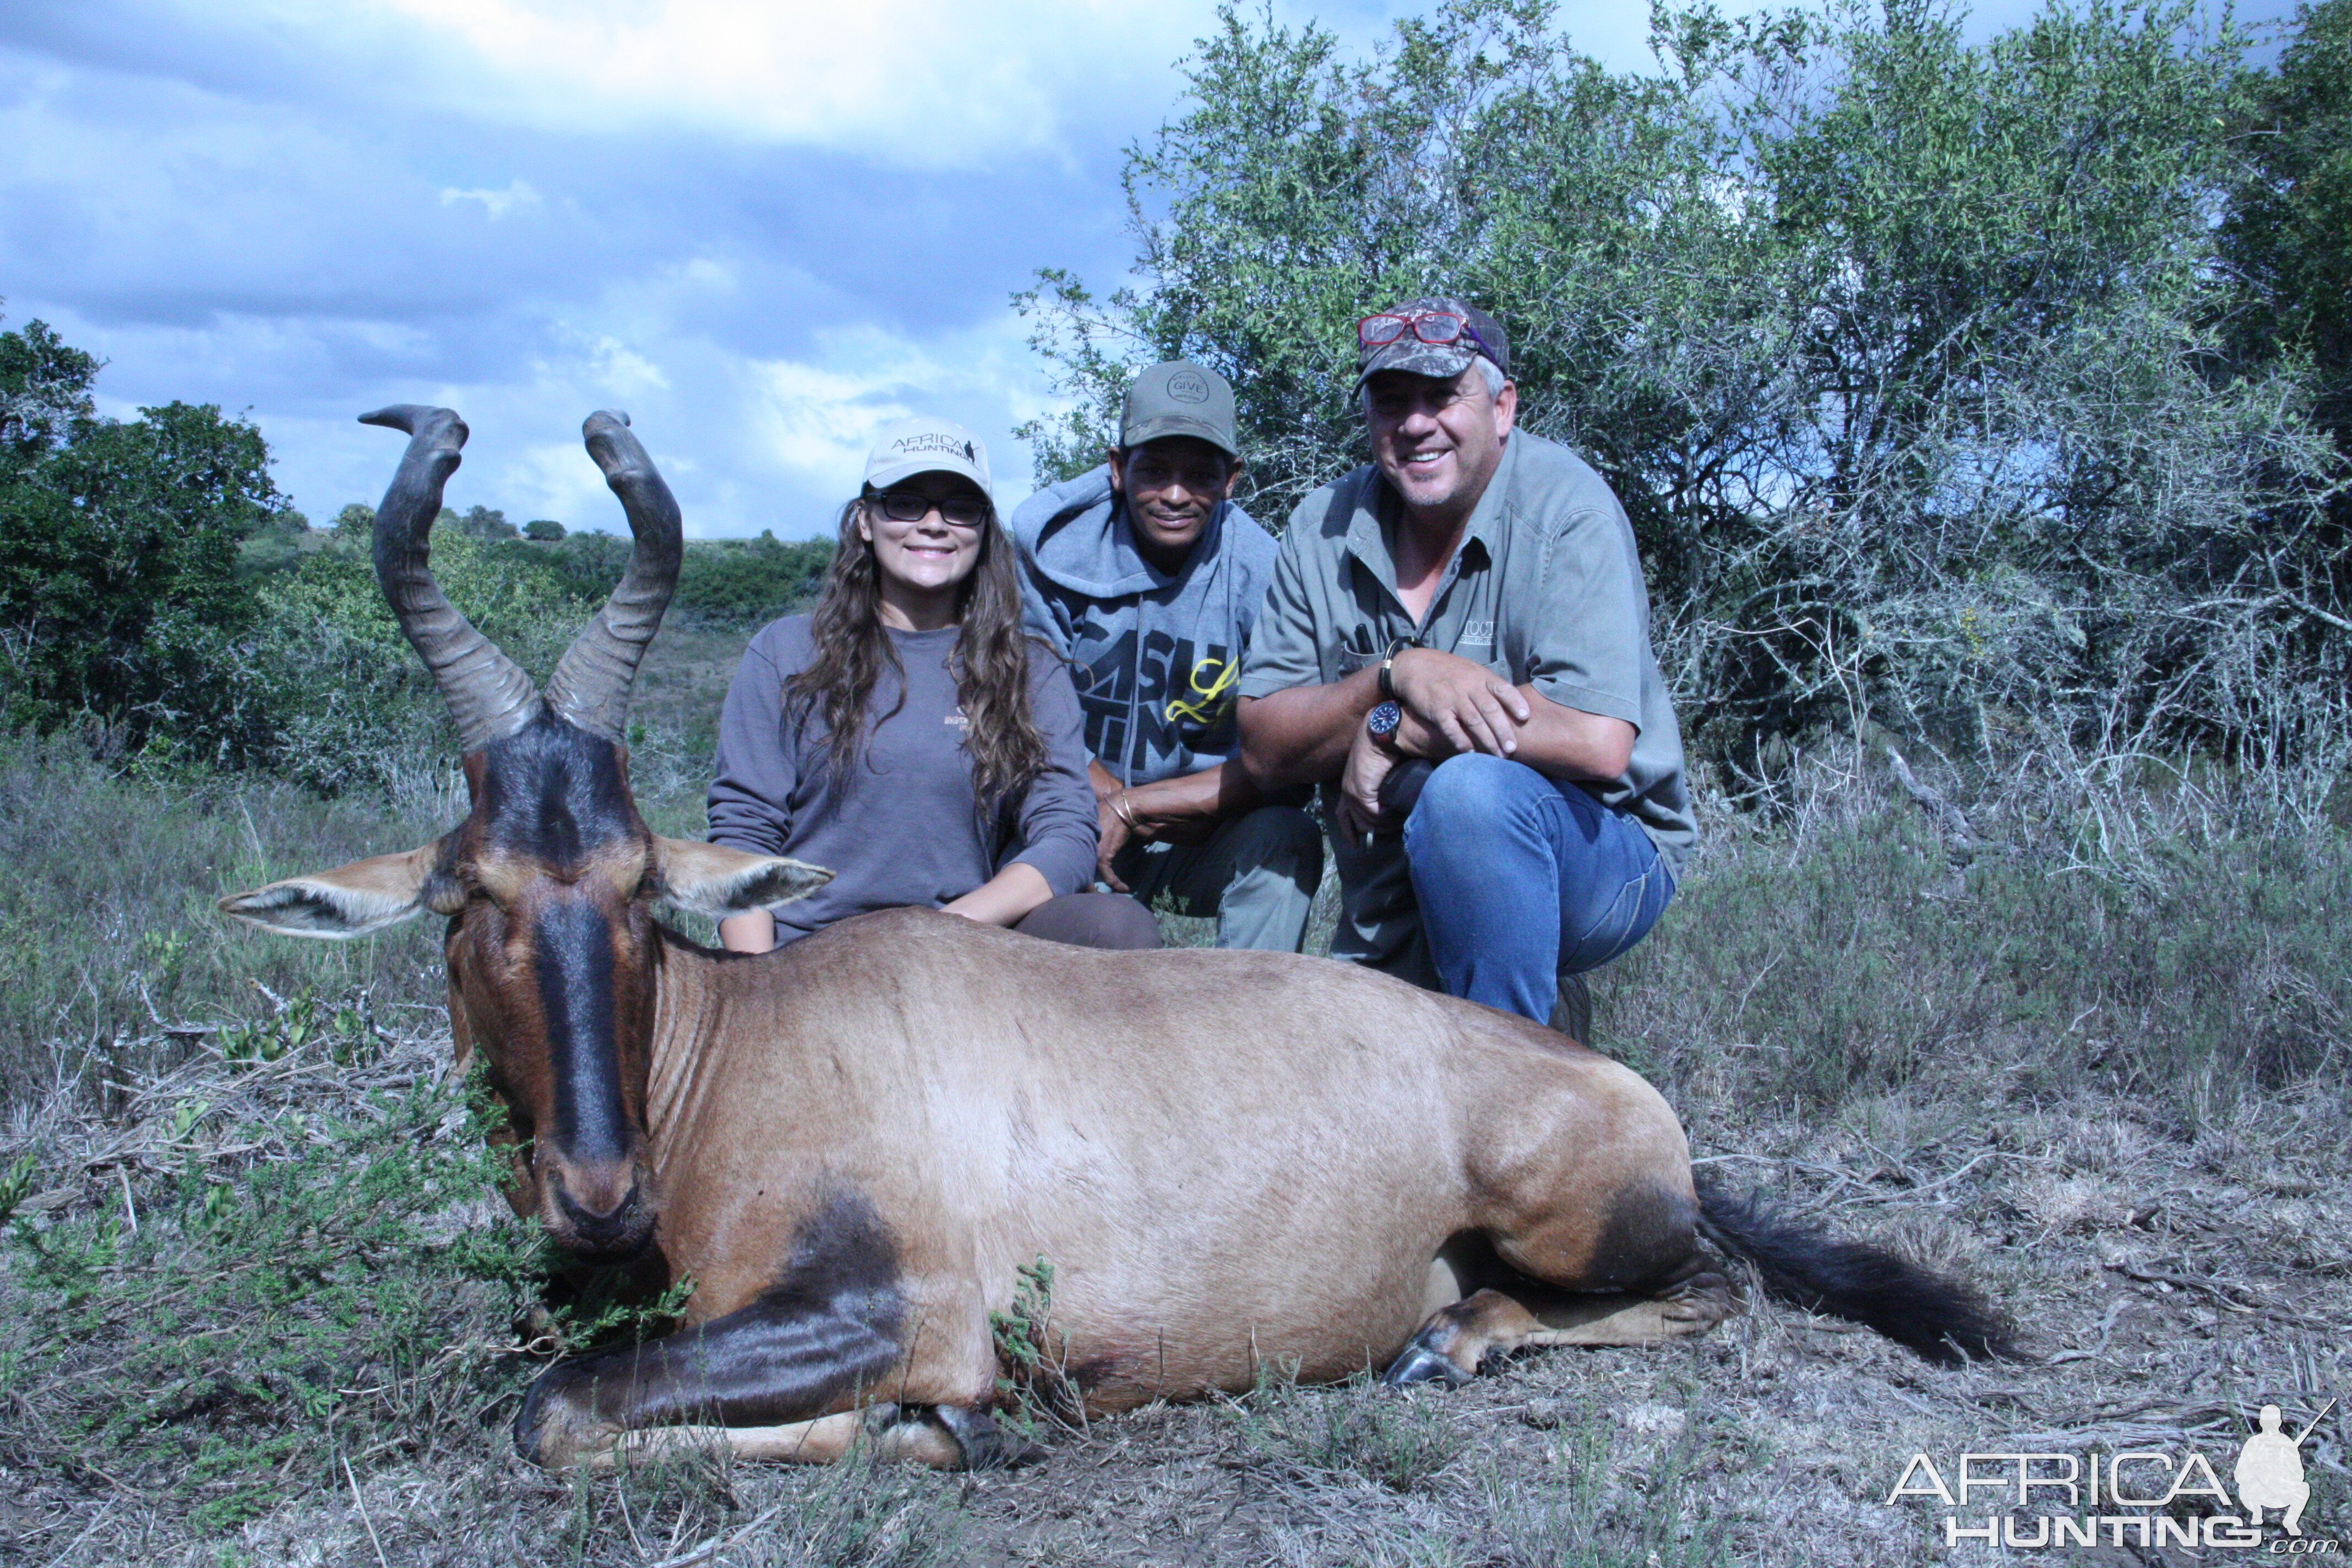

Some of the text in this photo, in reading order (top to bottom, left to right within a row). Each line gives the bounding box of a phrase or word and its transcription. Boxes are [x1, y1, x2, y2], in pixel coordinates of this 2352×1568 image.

[1174, 381, 1203, 394] GIVE
[892, 433, 964, 451] AFRICA
[903, 444, 968, 461] HUNTING
